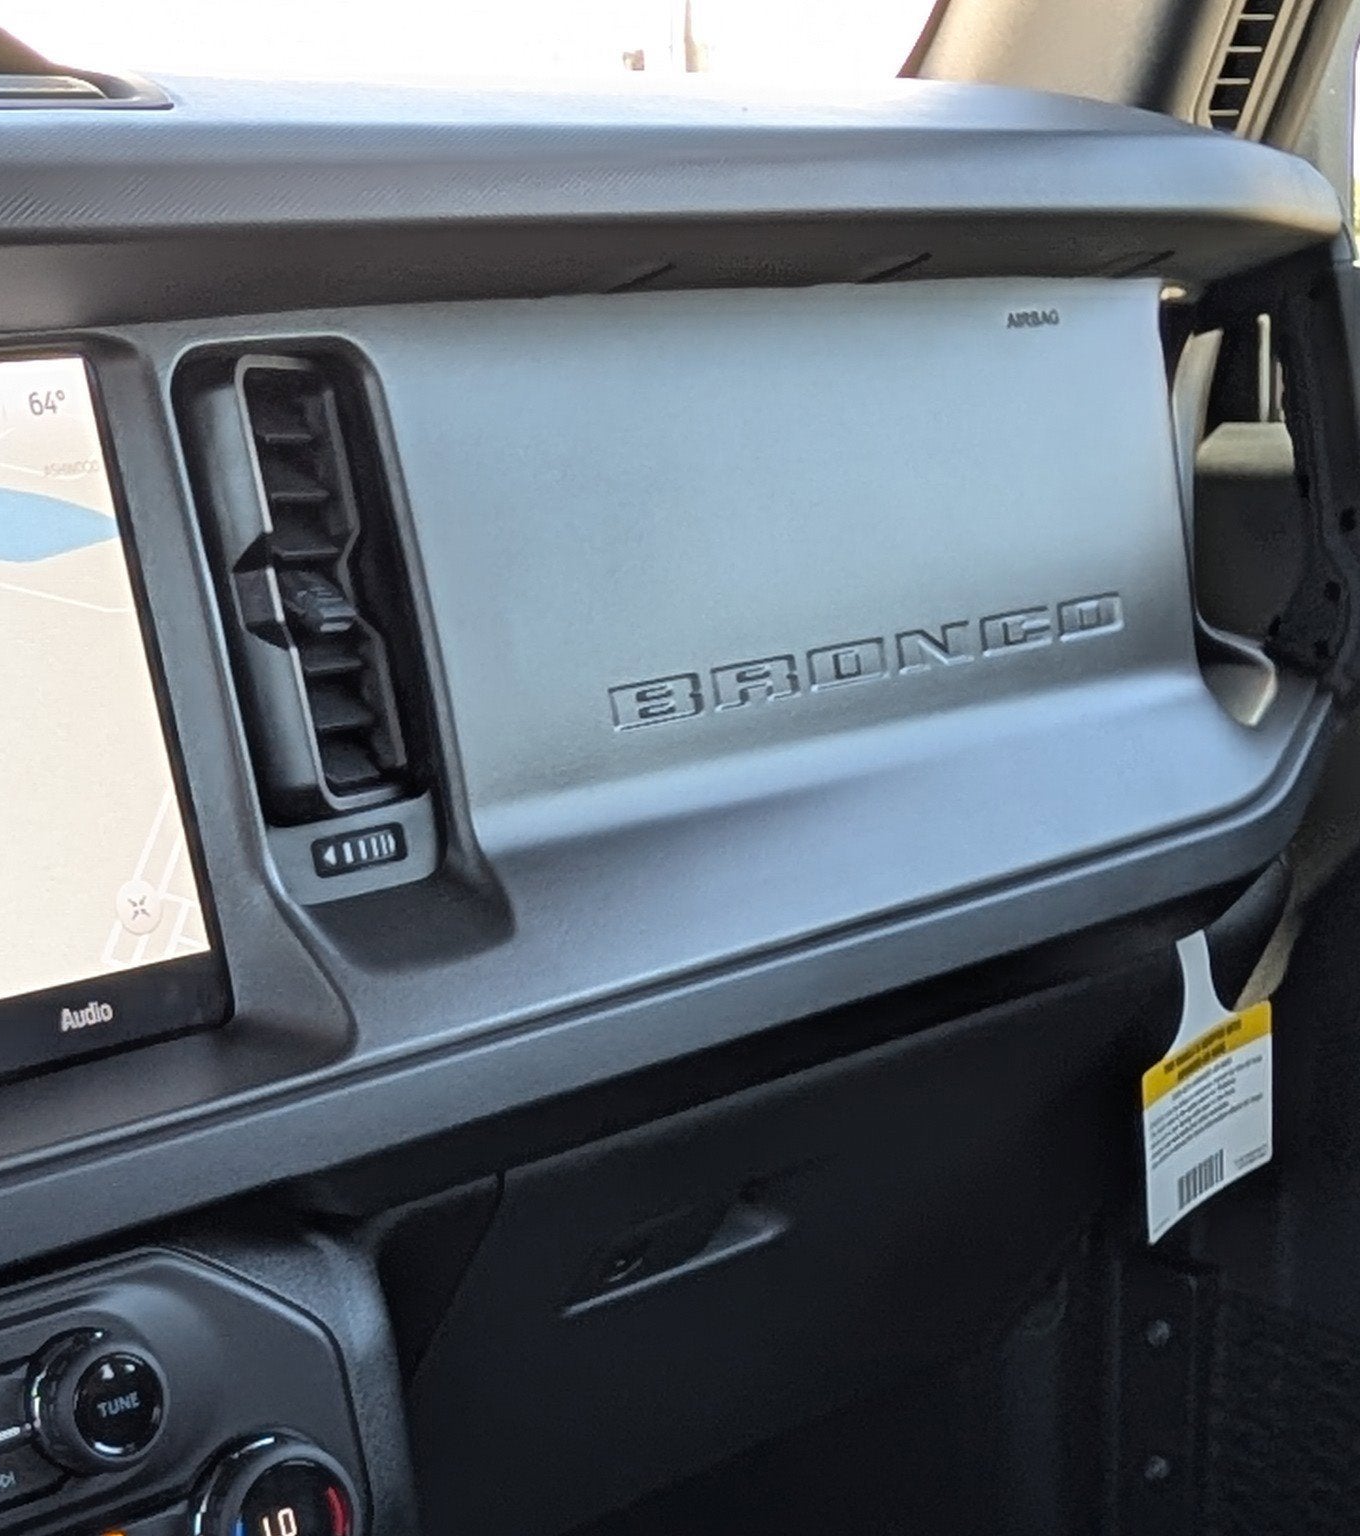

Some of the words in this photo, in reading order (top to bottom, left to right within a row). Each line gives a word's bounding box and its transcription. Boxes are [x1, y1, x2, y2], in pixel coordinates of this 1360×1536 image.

[607, 591, 1124, 732] BRONCO
[61, 1002, 113, 1032] Audio
[97, 1393, 140, 1418] TUNE
